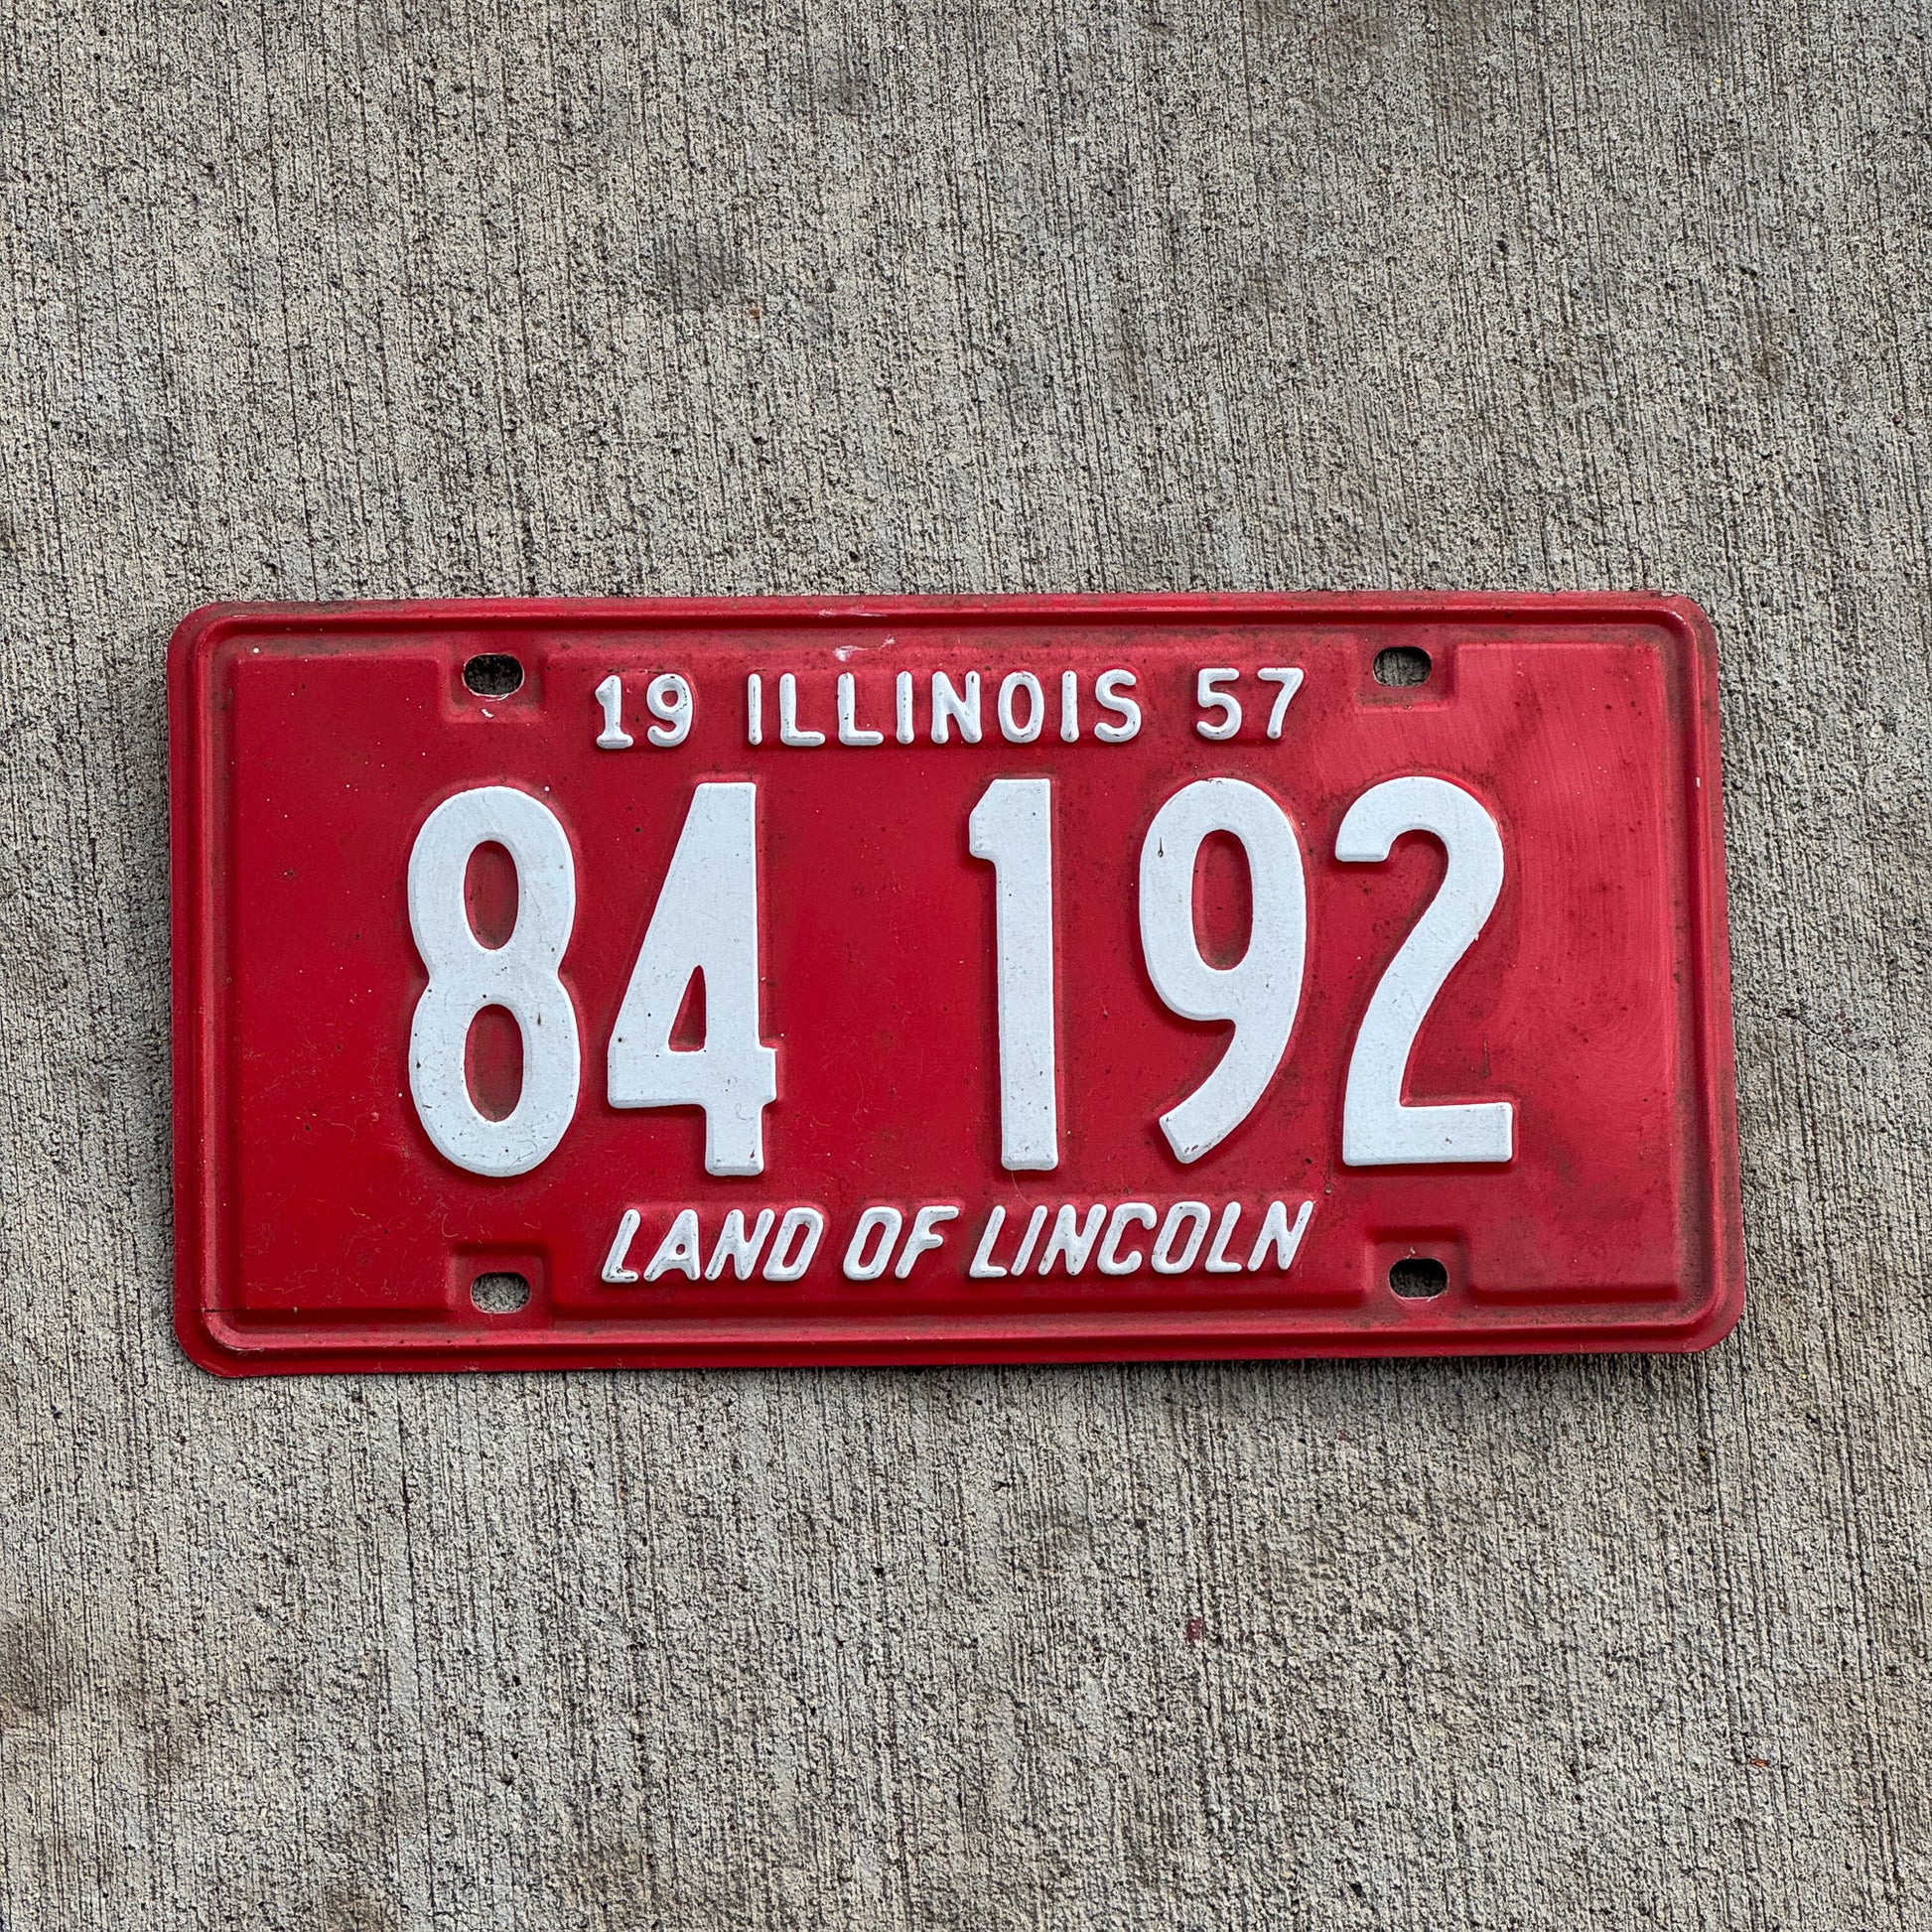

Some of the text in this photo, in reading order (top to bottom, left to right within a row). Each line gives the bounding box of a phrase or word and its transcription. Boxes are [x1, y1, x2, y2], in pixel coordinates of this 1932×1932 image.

[595, 667, 1306, 750] 19 ILLINOIS 57
[407, 776, 1514, 1177] 84 192
[601, 1199, 1316, 1283] LAND OF LINCOLN
